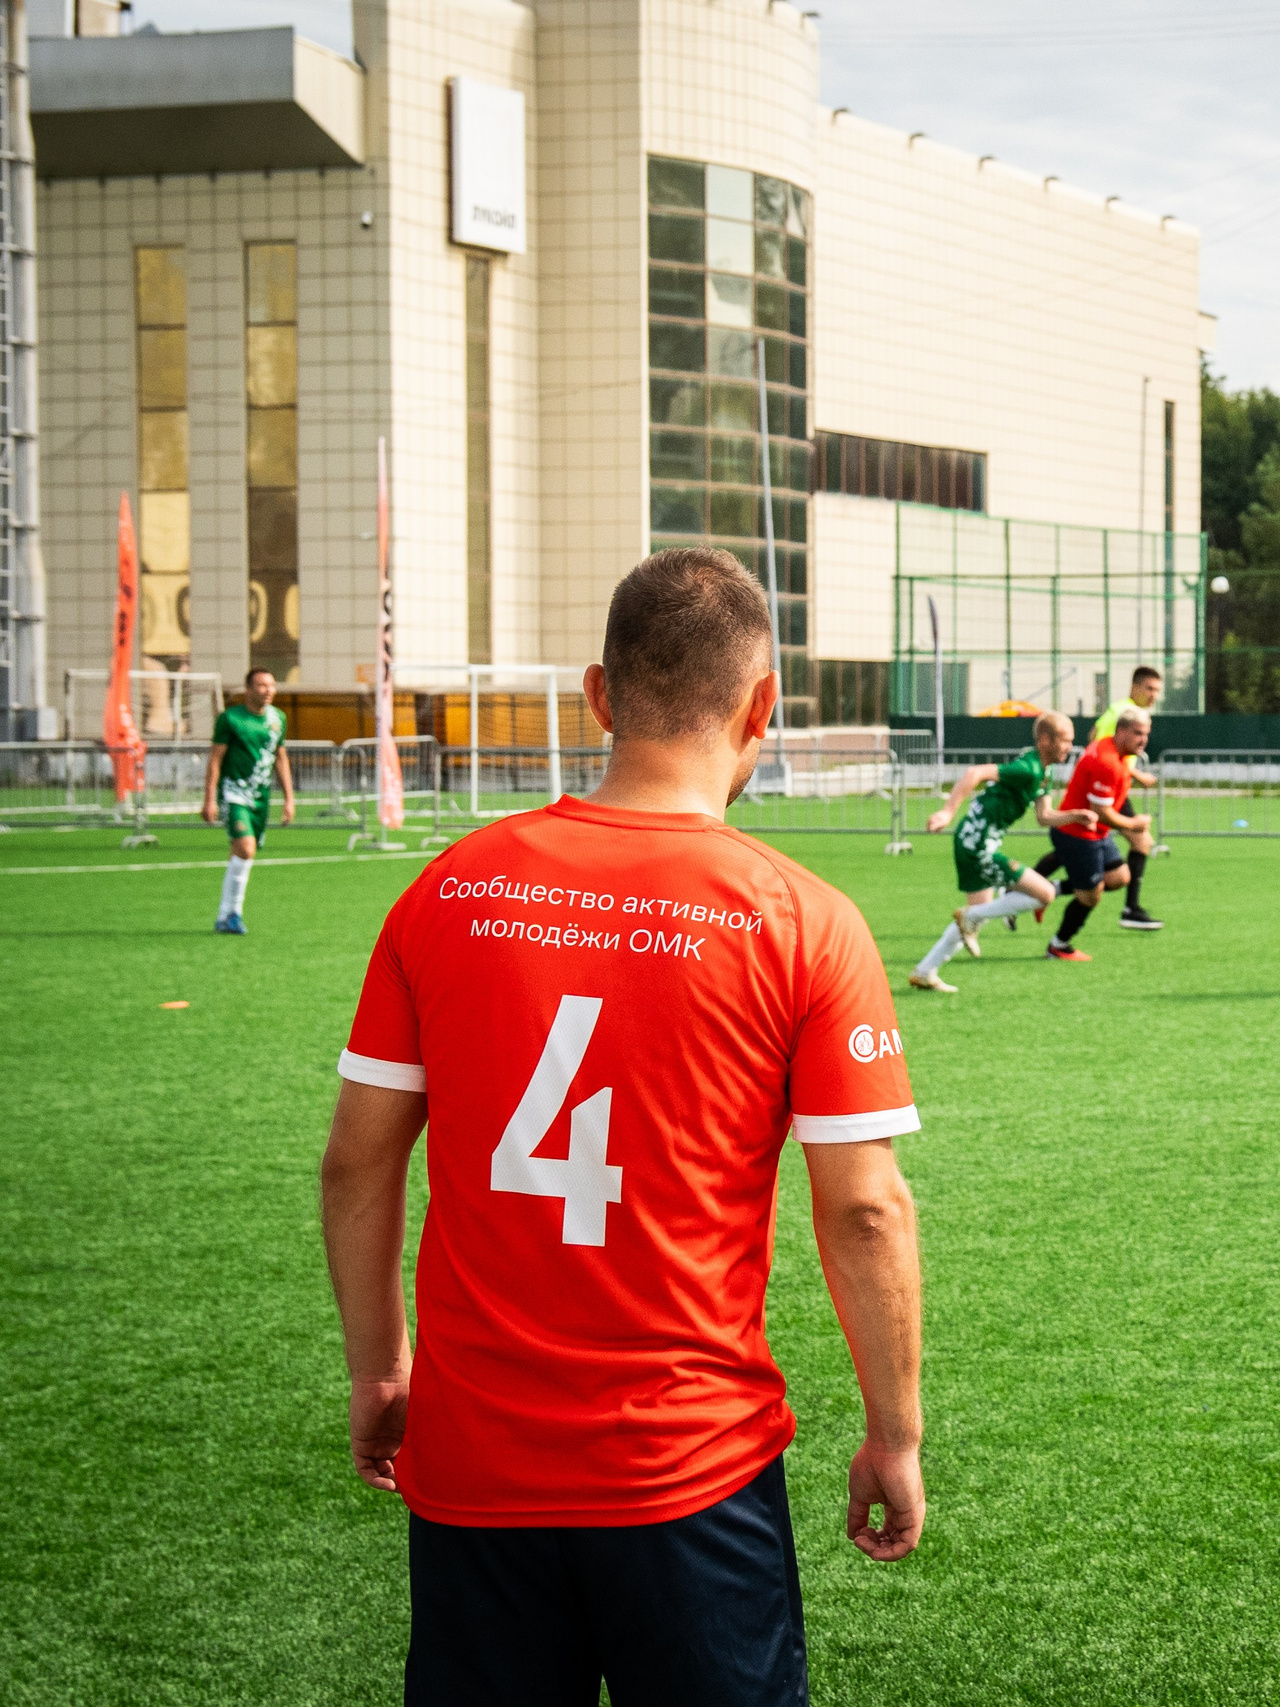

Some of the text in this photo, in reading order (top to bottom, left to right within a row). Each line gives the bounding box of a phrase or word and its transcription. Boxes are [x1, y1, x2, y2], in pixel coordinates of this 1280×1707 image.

[439, 875, 763, 935] Сообщество активной
[470, 919, 707, 961] молодёжи ОМК
[491, 994, 623, 1247] 4
